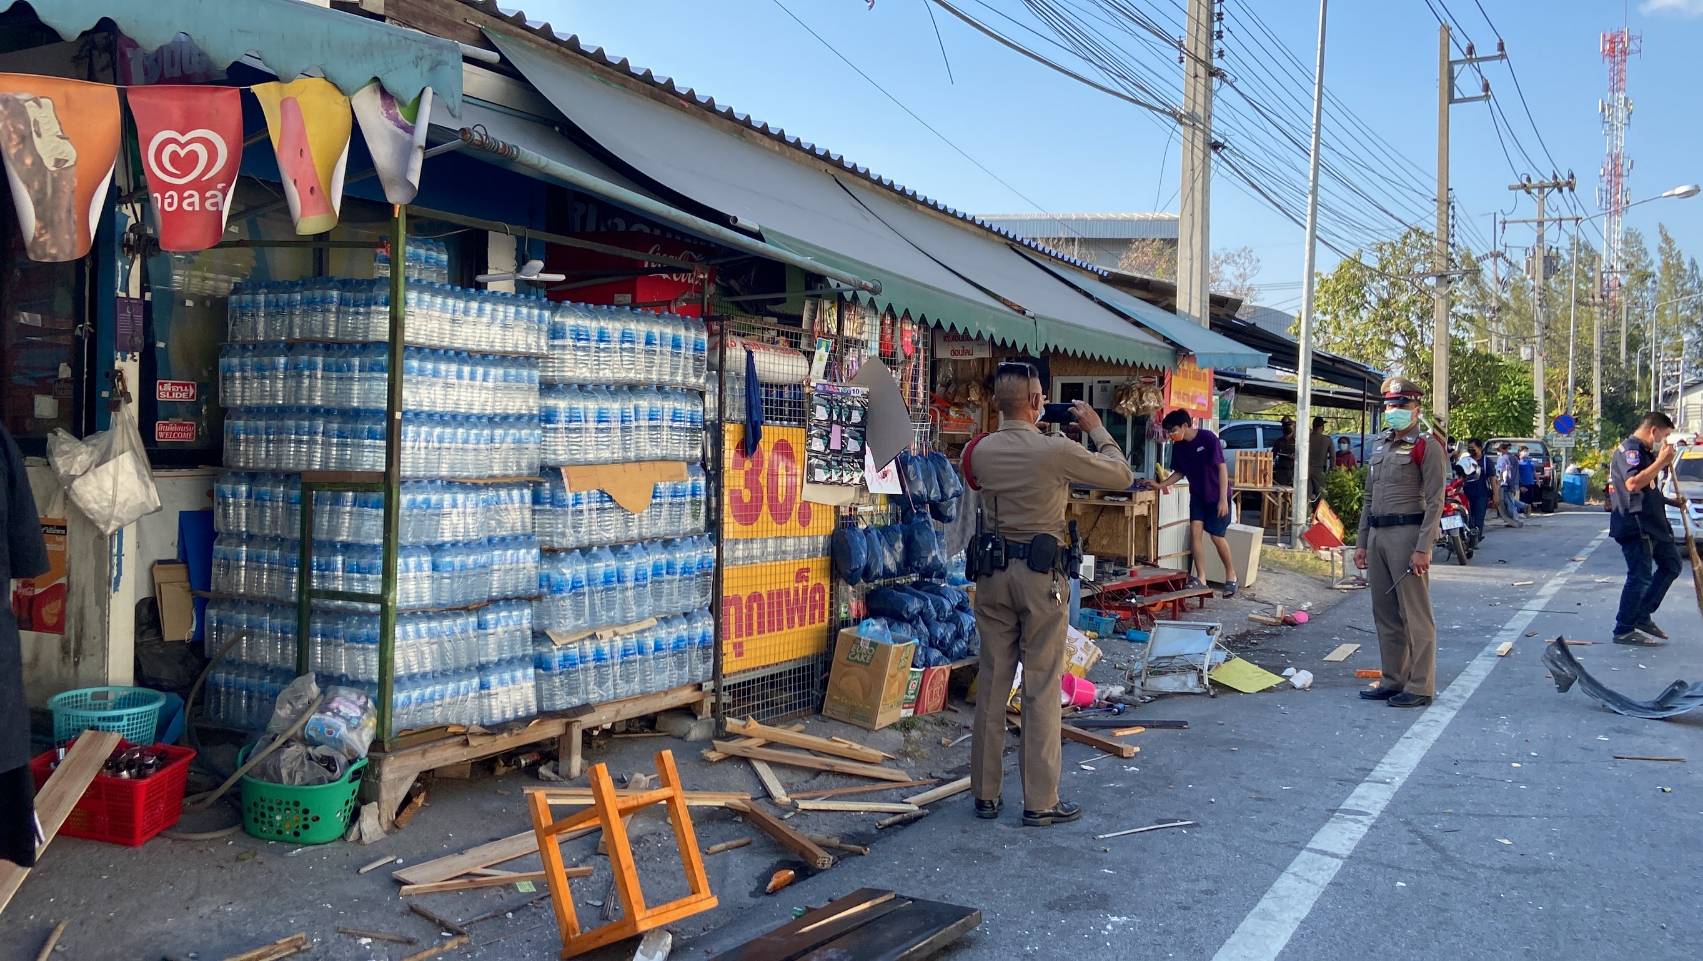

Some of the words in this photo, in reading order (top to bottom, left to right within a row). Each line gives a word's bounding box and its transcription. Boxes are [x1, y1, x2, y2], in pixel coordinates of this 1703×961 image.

[159, 391, 189, 399] SLIDE
[158, 431, 193, 440] WELCOME
[848, 653, 872, 663] CAKE
